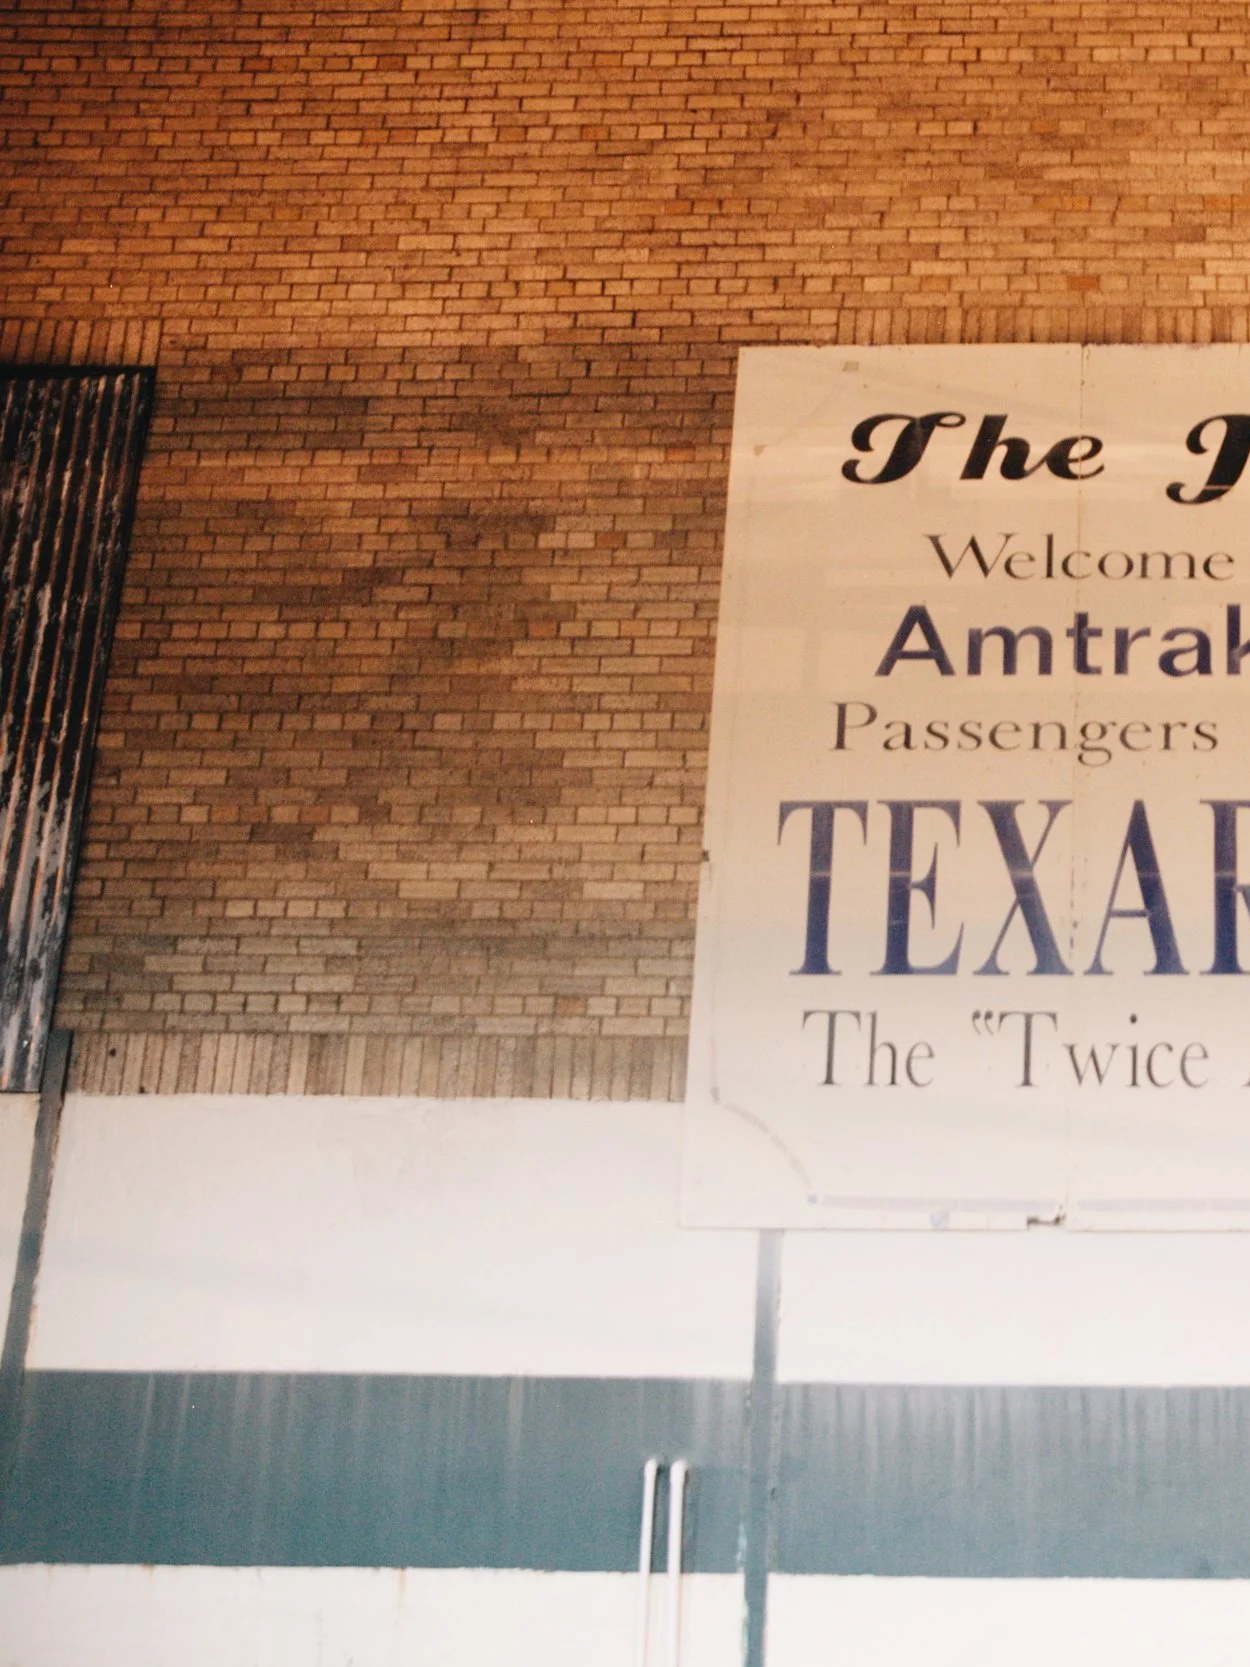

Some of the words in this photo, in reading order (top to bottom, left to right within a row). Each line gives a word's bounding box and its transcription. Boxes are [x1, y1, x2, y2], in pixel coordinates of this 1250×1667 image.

[841, 411, 1104, 484] The
[924, 532, 1235, 581] Welcome
[829, 702, 1218, 767] Passengers
[802, 1010, 935, 1087] The
[971, 1009, 1209, 1087] “Twice
